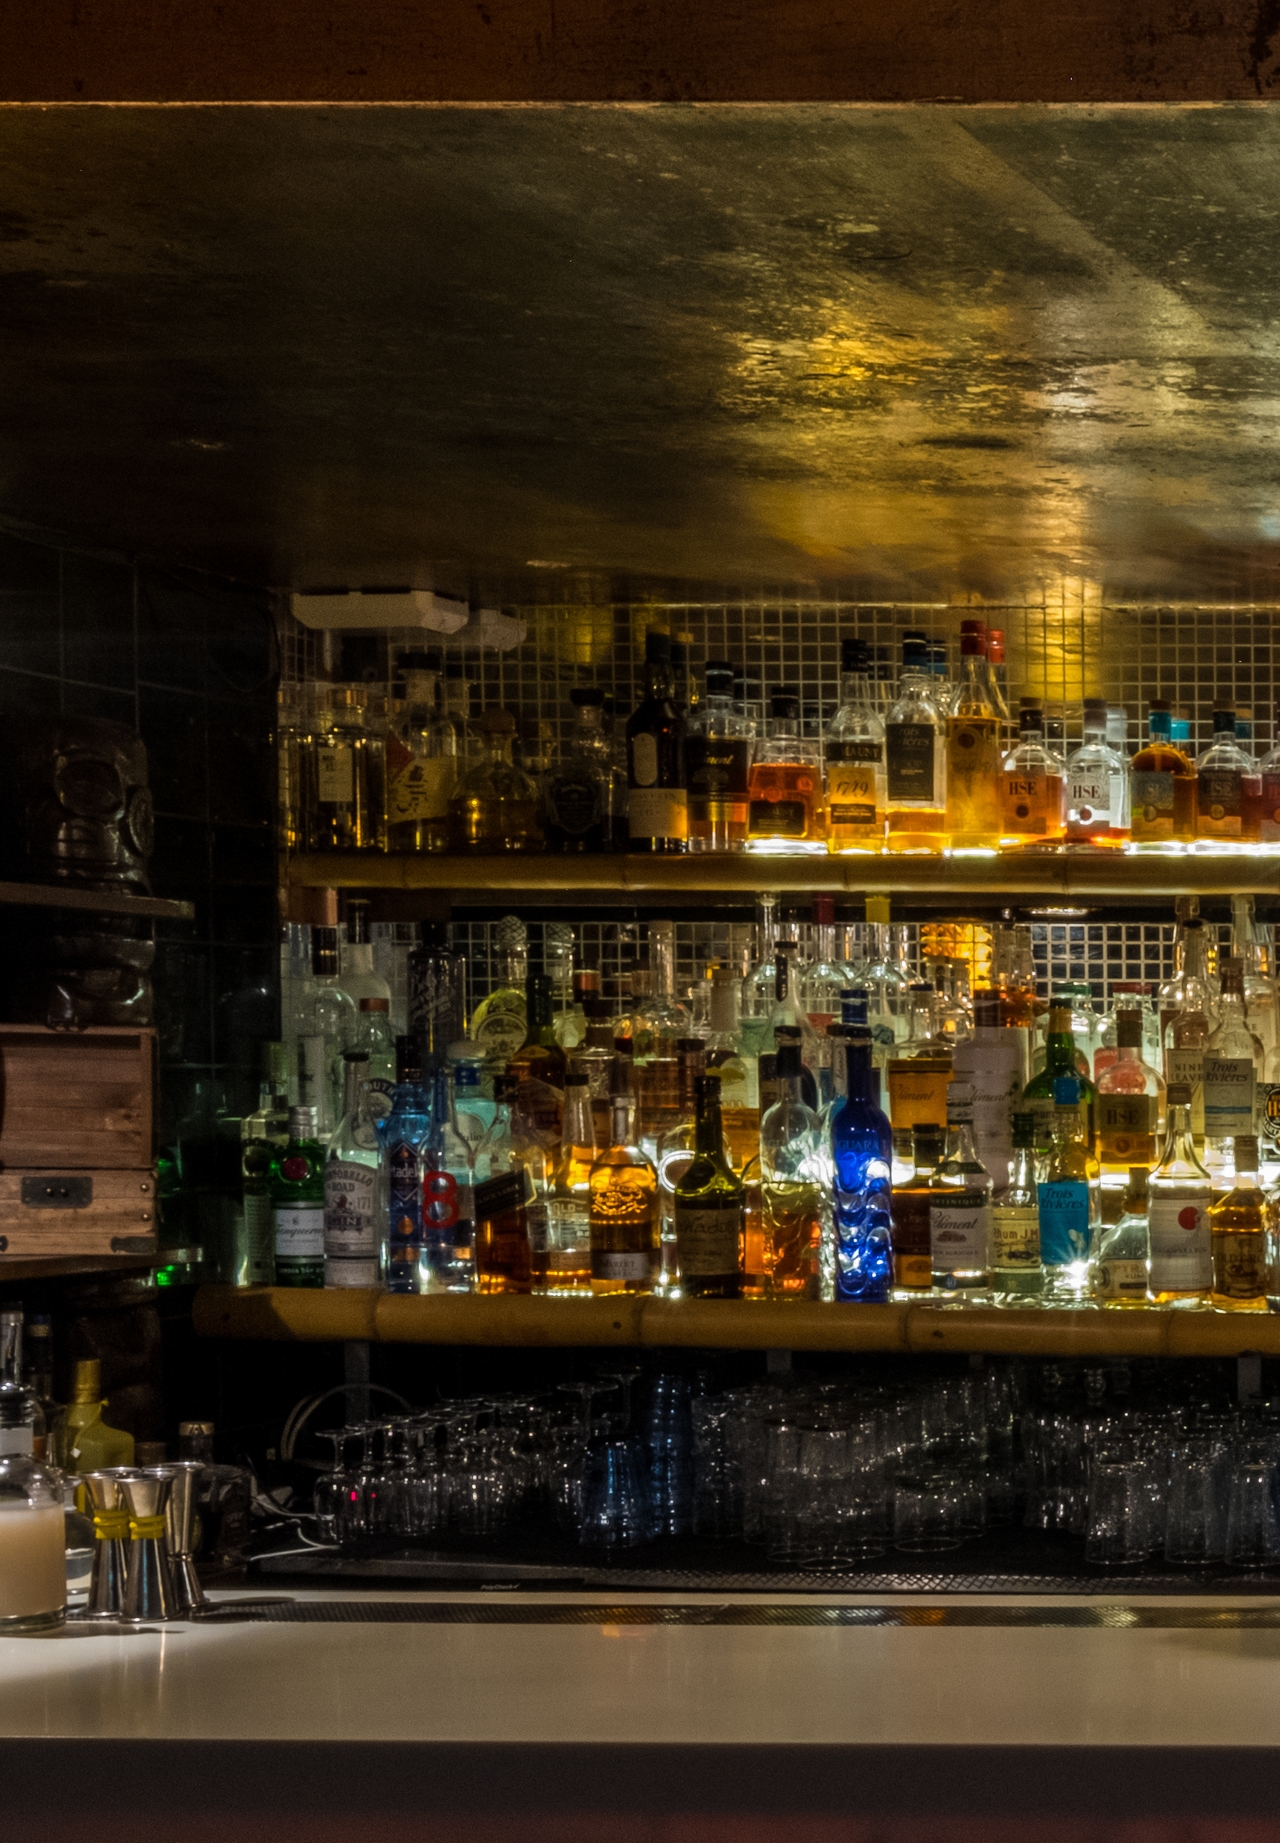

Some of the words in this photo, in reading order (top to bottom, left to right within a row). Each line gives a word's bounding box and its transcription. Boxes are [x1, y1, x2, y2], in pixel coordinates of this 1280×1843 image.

[1009, 781, 1037, 796] HSE
[1073, 784, 1101, 800] HSE
[1210, 1061, 1238, 1073] Trois
[1170, 1072, 1205, 1082] LEAVE
[1106, 1109, 1140, 1126] HSE
[331, 1182, 356, 1193] ROAD
[1044, 1188, 1074, 1199] Trois
[422, 1170, 460, 1229] 8
[993, 1227, 1018, 1240] Rhum
